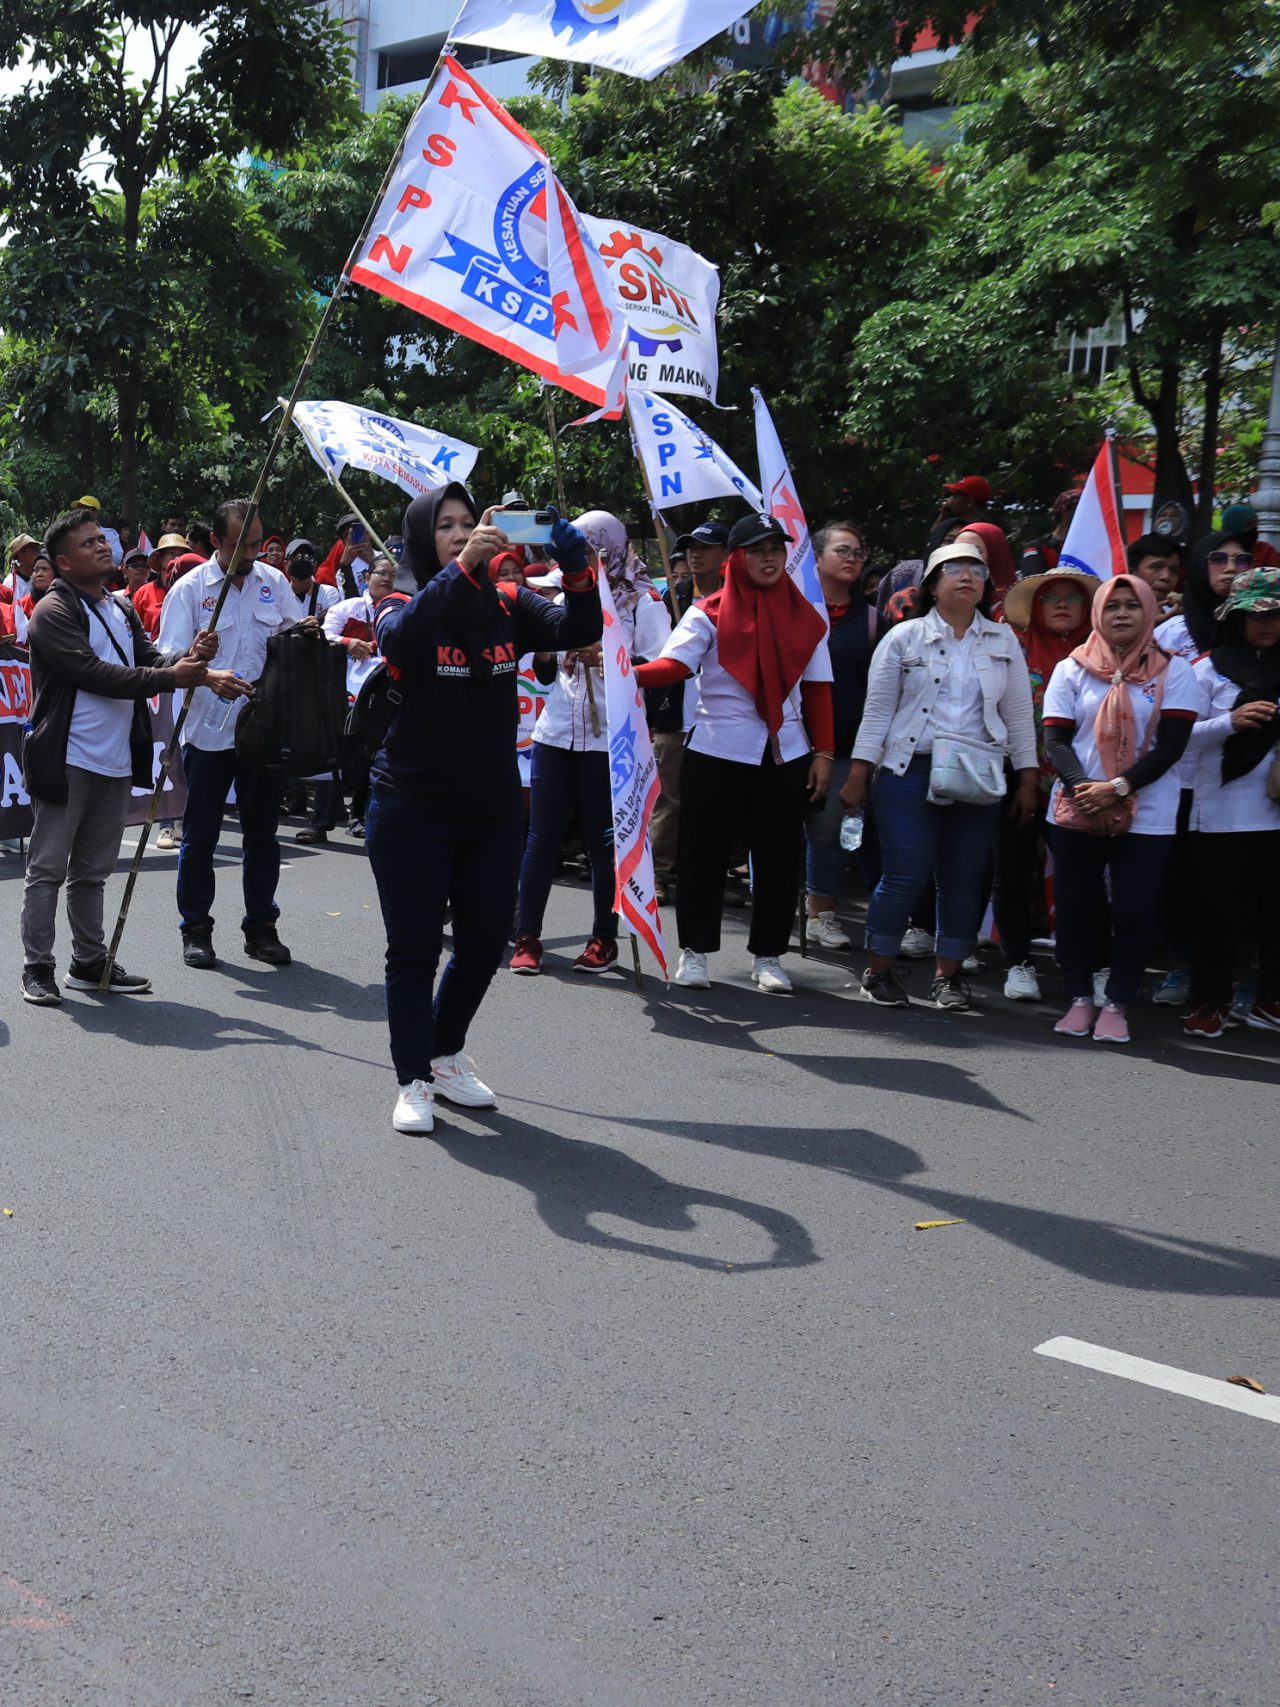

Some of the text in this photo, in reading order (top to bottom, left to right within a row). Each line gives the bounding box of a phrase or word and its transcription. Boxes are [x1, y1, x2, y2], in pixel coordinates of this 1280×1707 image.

[501, 186, 530, 263] KESATUAN
[474, 275, 557, 336] KSP
[363, 451, 390, 471] KOTA
